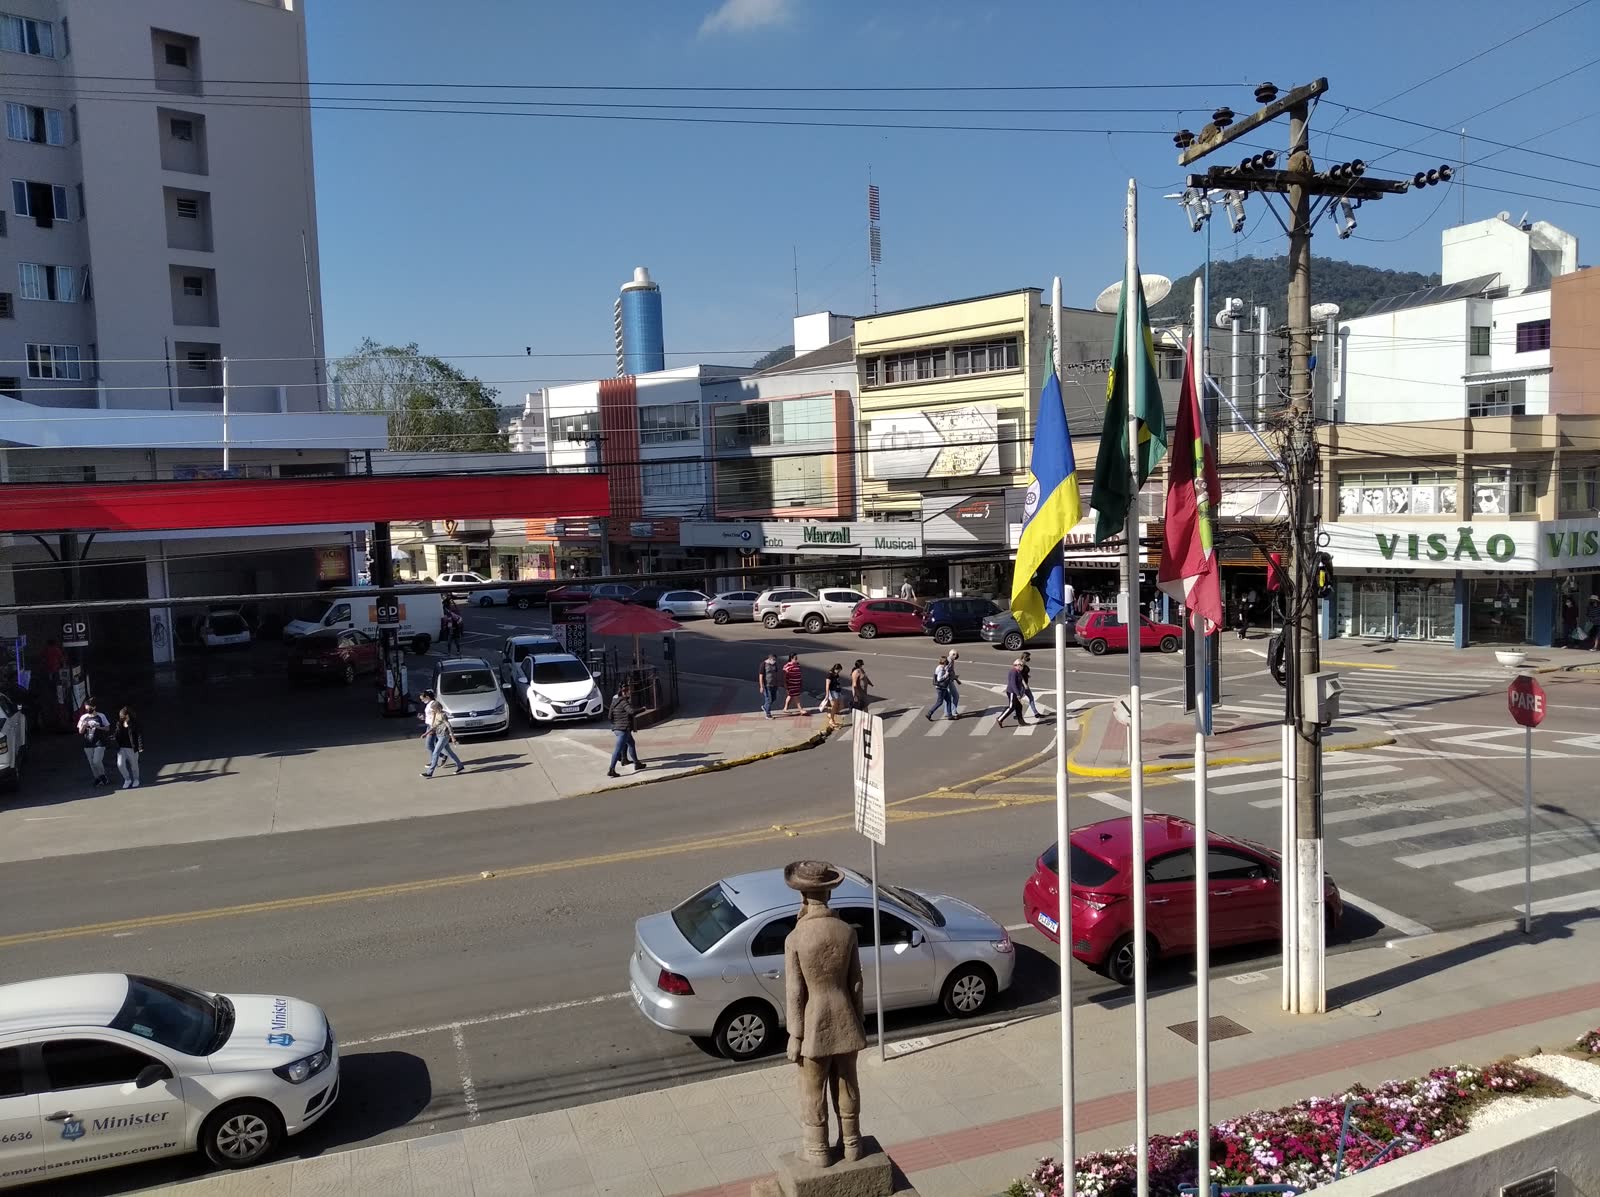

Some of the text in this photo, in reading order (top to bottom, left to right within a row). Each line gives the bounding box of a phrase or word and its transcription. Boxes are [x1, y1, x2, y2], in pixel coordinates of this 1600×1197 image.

[763, 535, 784, 547] Foto
[803, 526, 851, 544] Marzall
[874, 537, 917, 550] Musical
[1375, 526, 1516, 563] VISÃO
[63, 622, 86, 633] G D
[1511, 690, 1543, 713] PARE
[863, 728, 872, 760] E
[271, 998, 287, 1031] Minister
[92, 1111, 170, 1132] Minister
